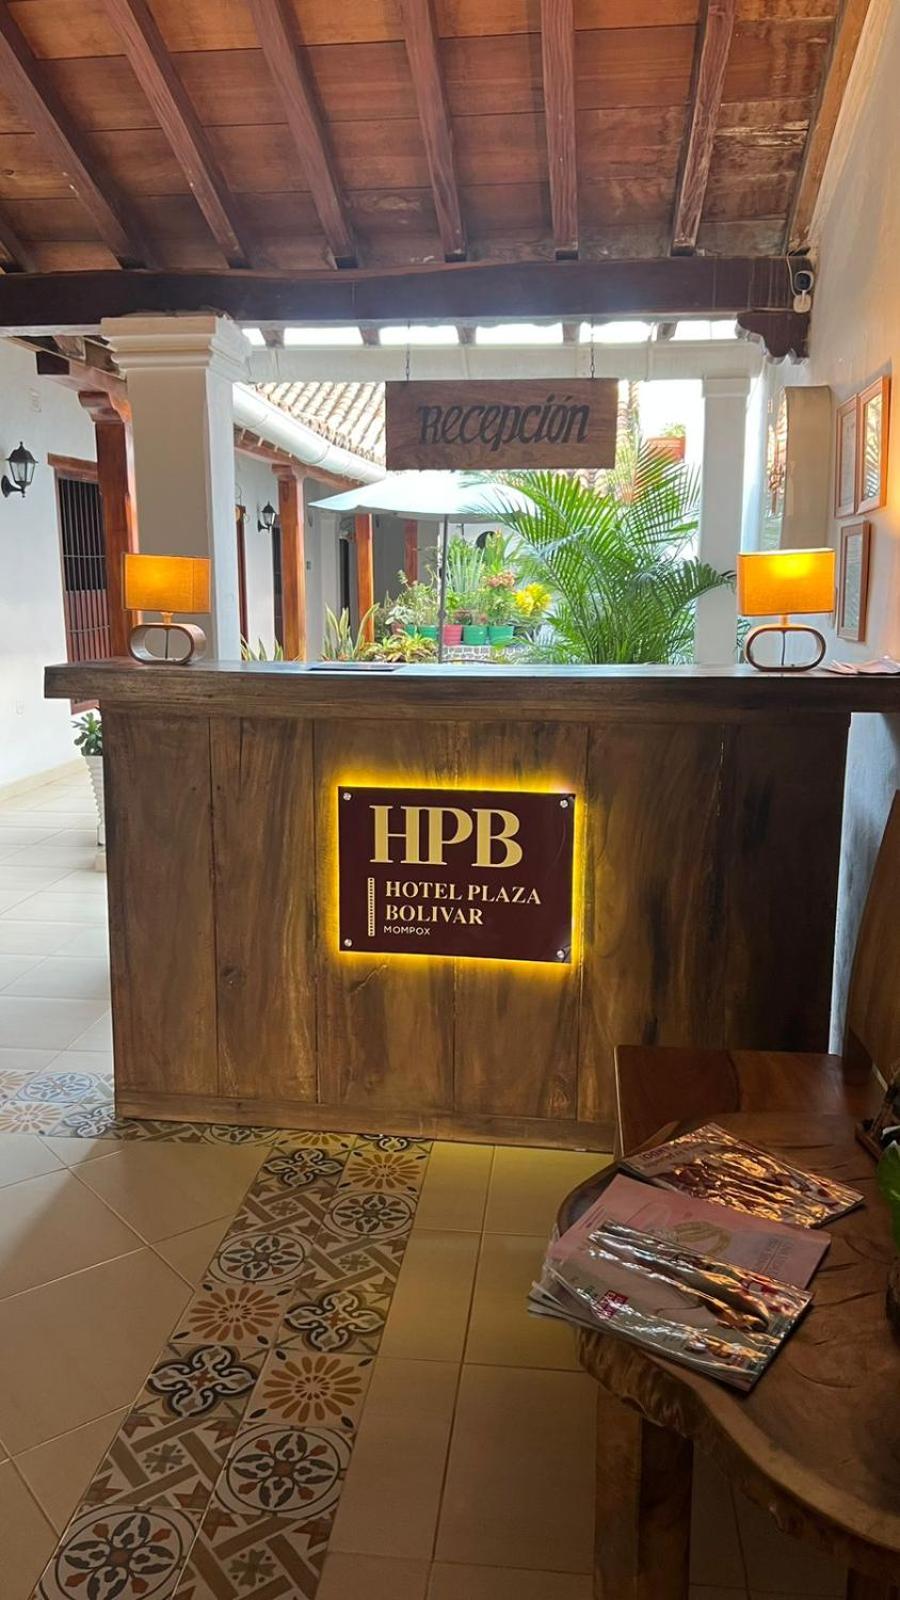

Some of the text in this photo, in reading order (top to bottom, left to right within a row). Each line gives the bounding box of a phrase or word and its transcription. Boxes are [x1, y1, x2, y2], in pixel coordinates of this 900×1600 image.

[418, 394, 590, 451] Recepción
[369, 805, 523, 868] HPB
[385, 881, 541, 905] HOTEL PLAZA
[385, 904, 483, 925] BOLIVAR
[383, 925, 431, 936] MOMPOX
